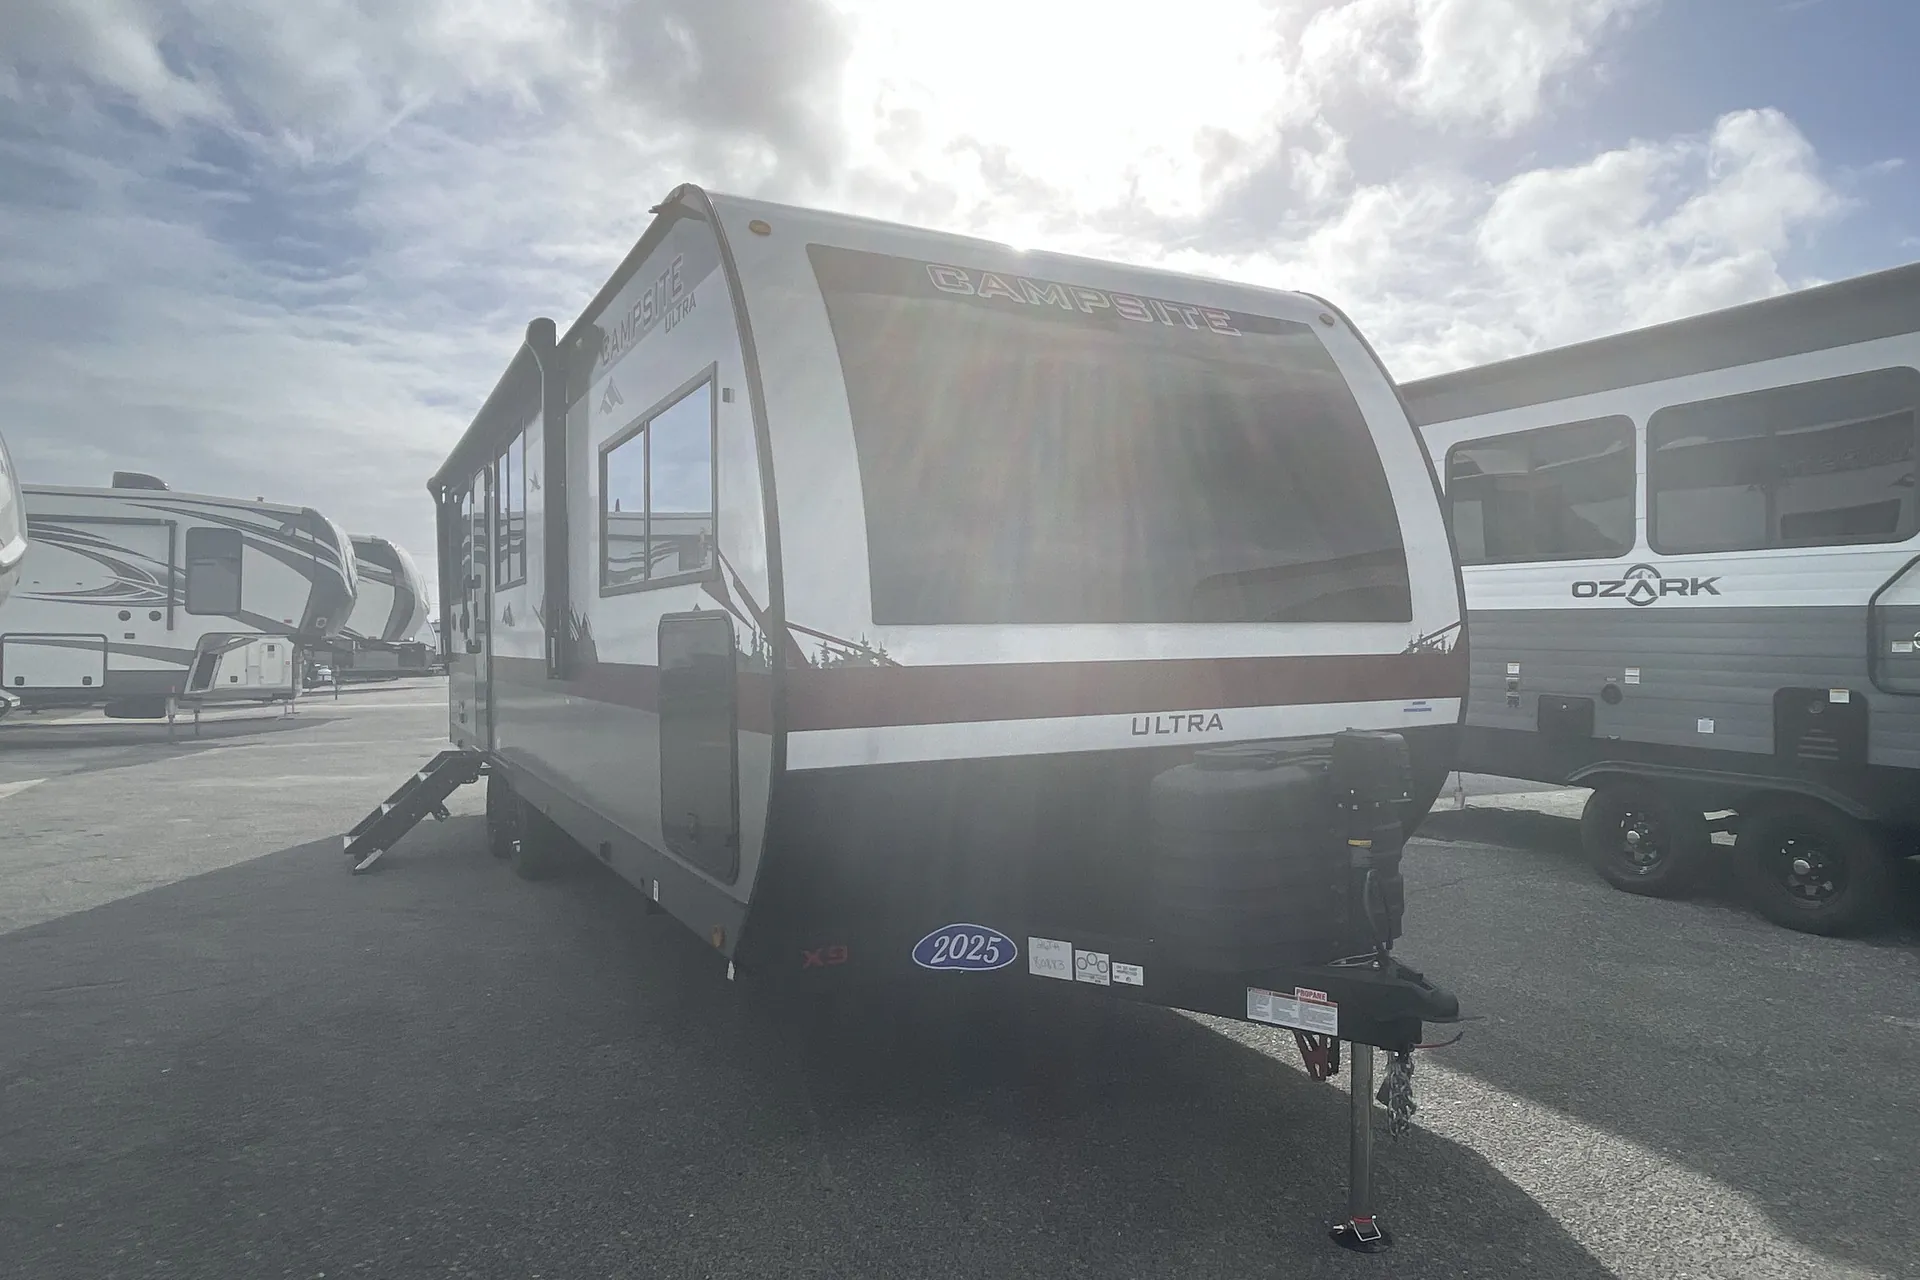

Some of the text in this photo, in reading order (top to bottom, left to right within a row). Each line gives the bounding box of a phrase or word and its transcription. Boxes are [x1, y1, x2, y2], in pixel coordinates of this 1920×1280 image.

[601, 253, 684, 366] CAMPSITE
[664, 291, 697, 334] ULTRA
[926, 264, 1242, 337] CAMPSITE
[1131, 712, 1224, 736] ULTRA
[930, 933, 1002, 964] 2025
[1295, 987, 1326, 1001] PROPANE
